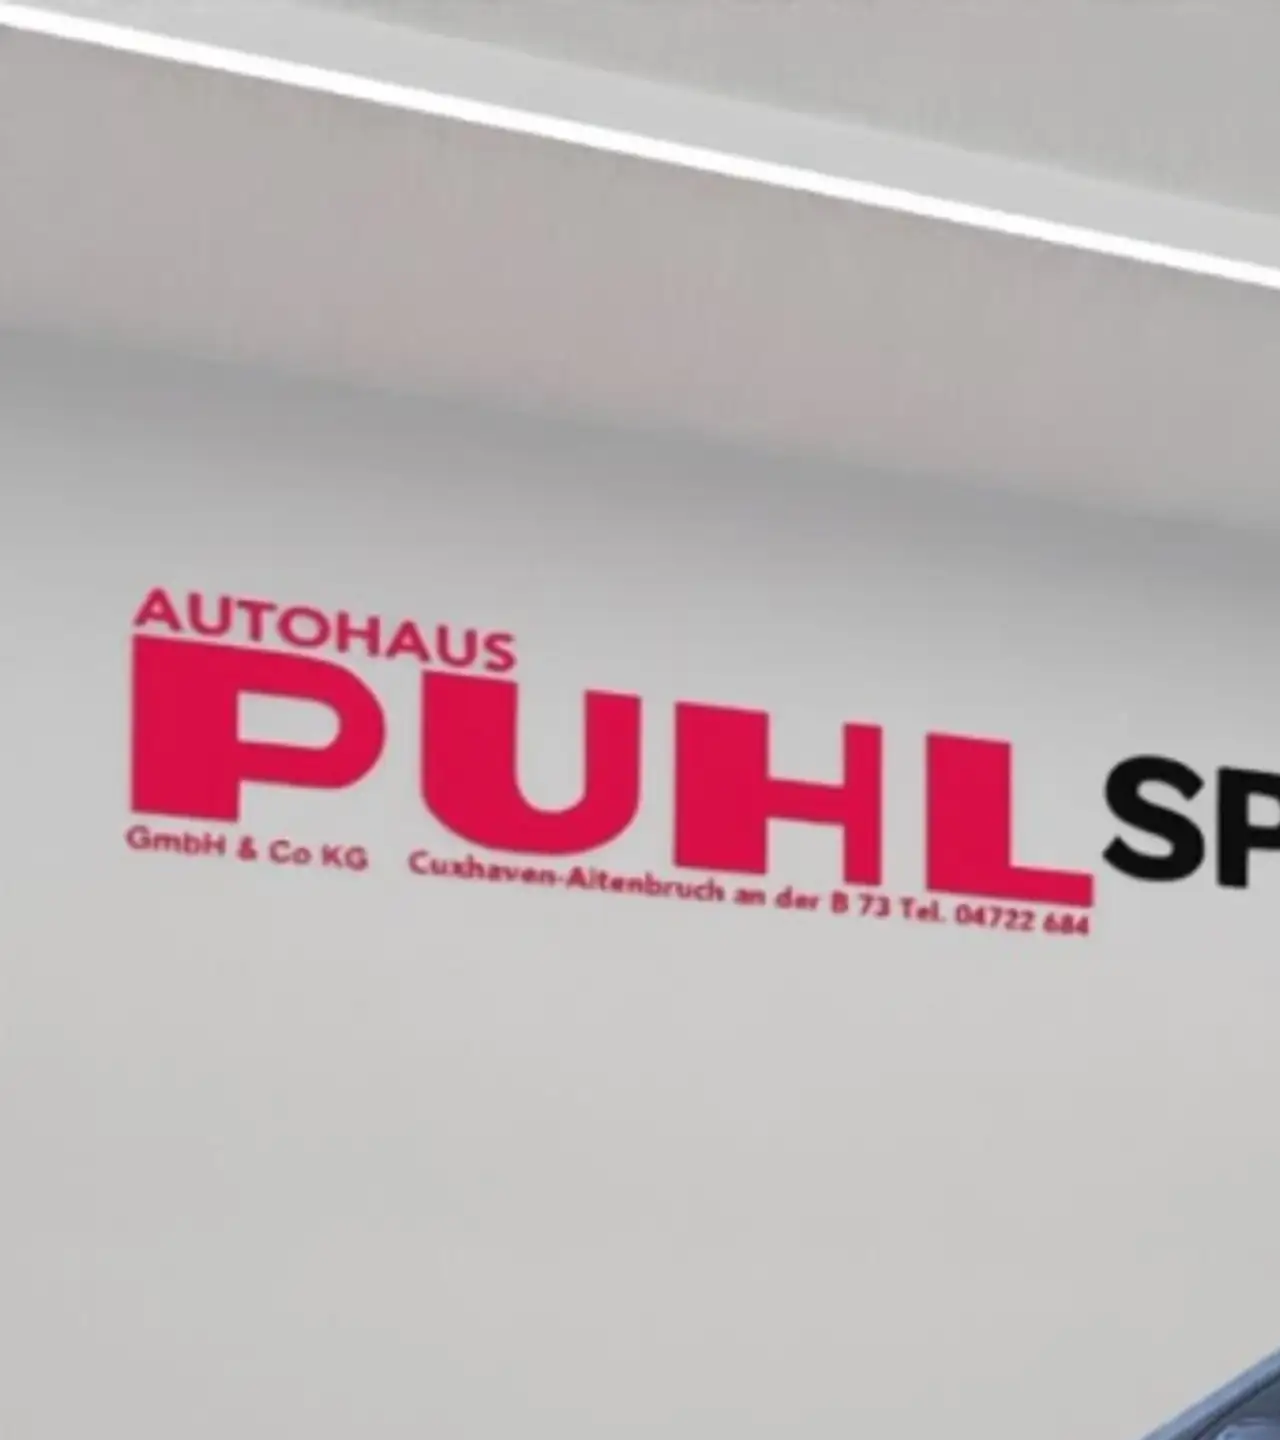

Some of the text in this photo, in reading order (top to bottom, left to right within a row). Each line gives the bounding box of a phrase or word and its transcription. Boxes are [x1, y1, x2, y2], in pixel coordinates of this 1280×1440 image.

[133, 588, 517, 672] AUTOHAUS
[131, 635, 1093, 909] PUHL
[125, 825, 227, 857] GmbH
[236, 836, 259, 861] &
[269, 840, 312, 864] Co
[321, 844, 369, 871] KG
[734, 888, 766, 906] an
[774, 887, 820, 911] der
[830, 892, 849, 914] B
[859, 894, 891, 917] 73
[900, 898, 946, 923] Tel.
[954, 903, 1036, 932] 04722
[1043, 912, 1090, 935] 684
